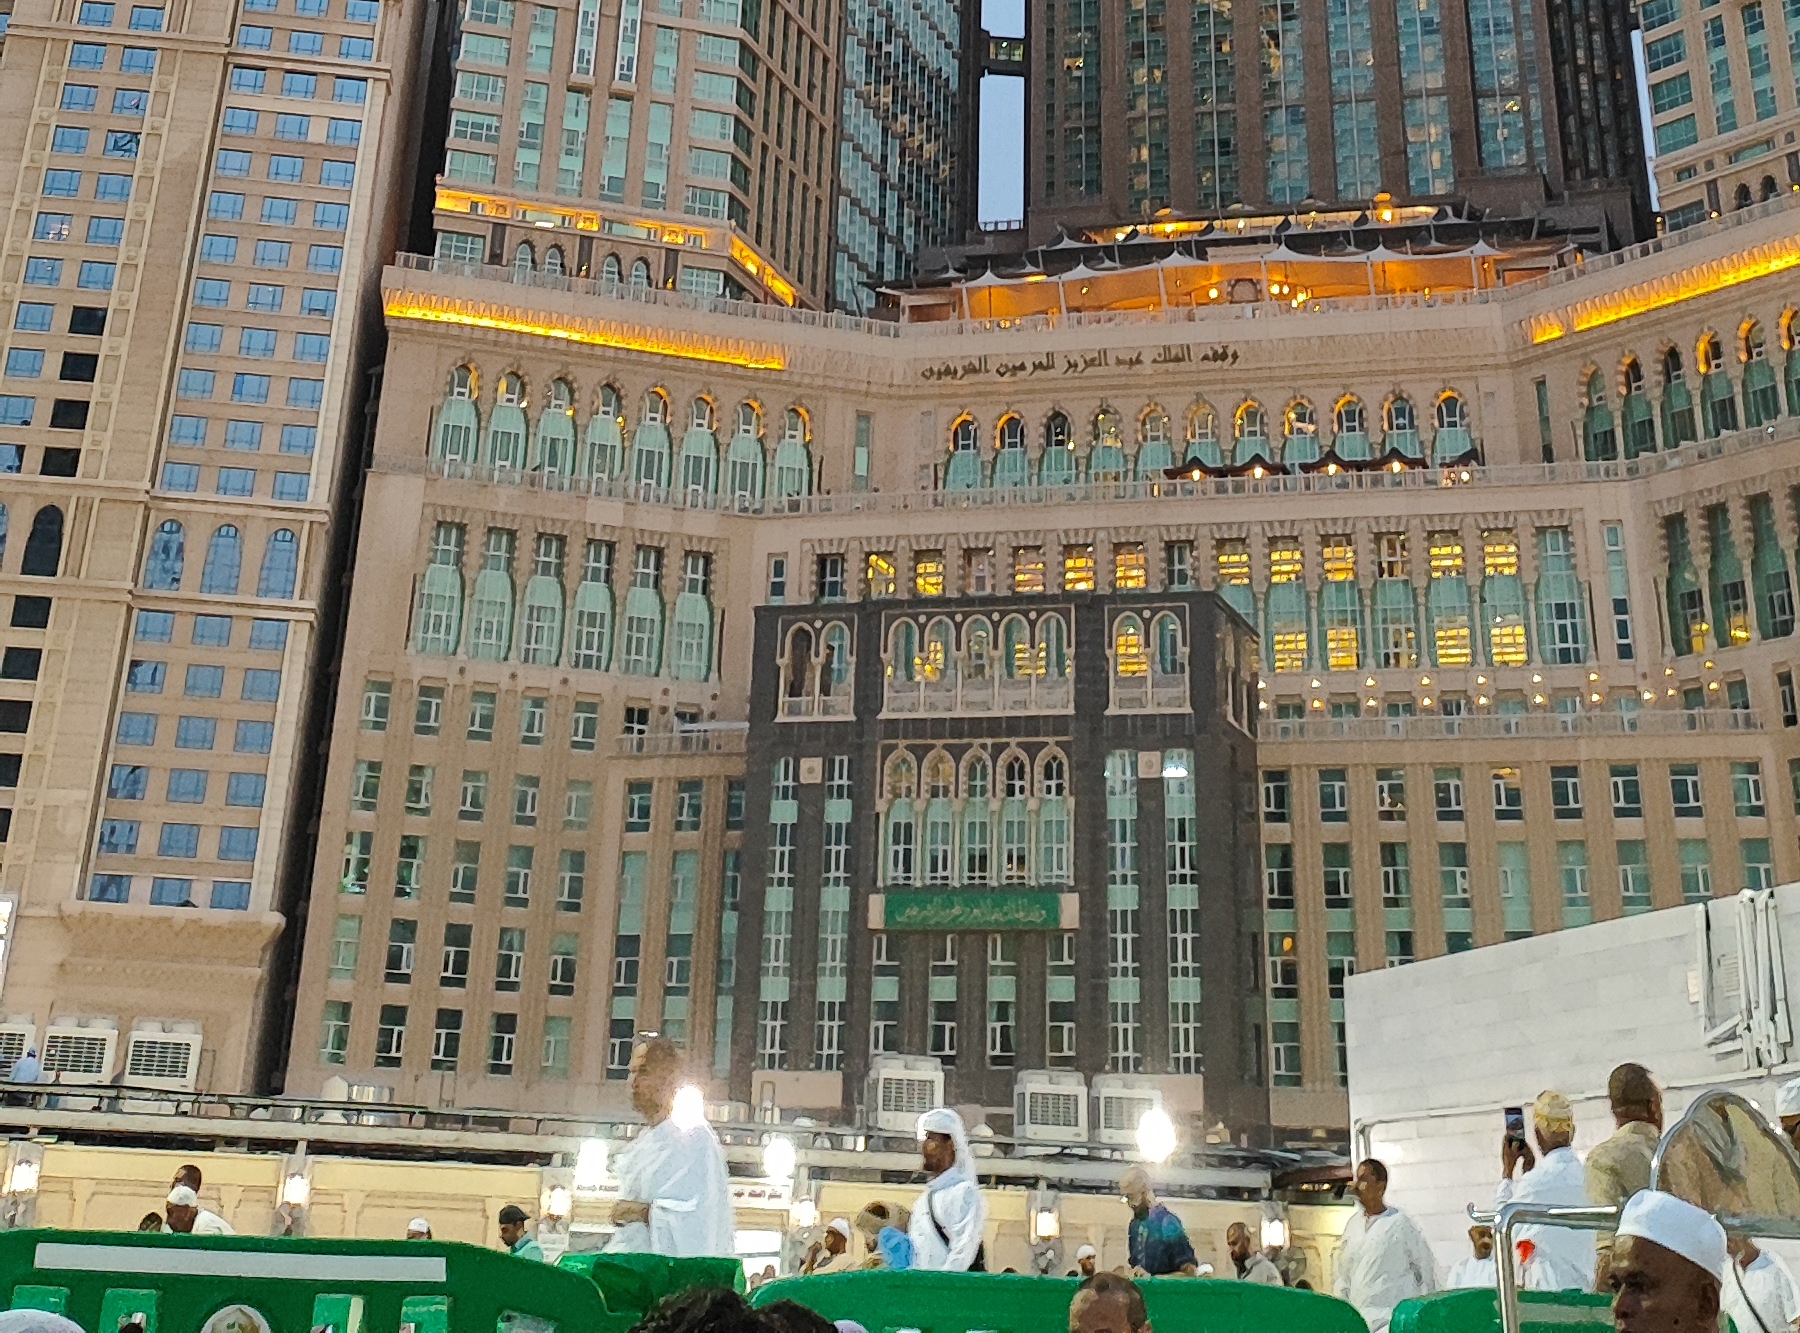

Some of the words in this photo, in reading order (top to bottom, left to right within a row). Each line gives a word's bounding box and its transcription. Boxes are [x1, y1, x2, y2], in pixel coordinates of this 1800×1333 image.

[1061, 347, 1110, 376] العزيز
[1114, 350, 1145, 371] عبد
[1150, 343, 1193, 365] الملك
